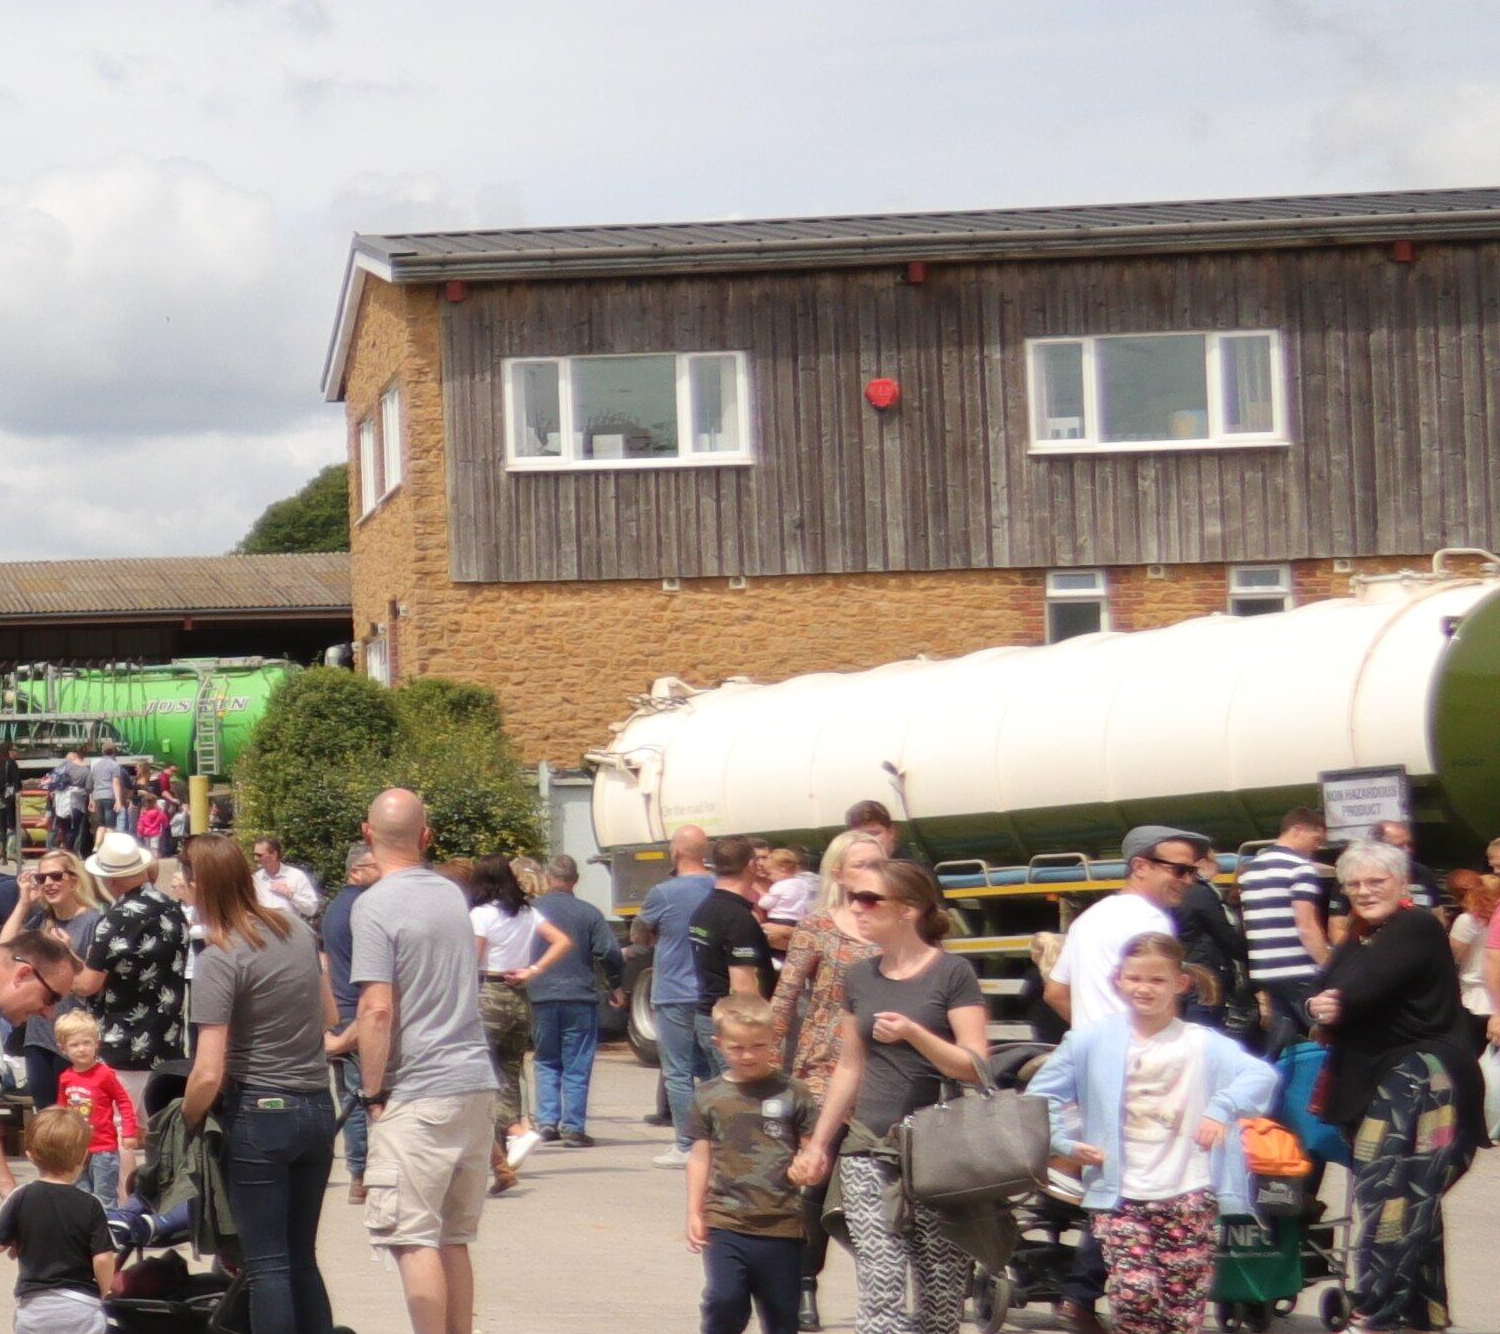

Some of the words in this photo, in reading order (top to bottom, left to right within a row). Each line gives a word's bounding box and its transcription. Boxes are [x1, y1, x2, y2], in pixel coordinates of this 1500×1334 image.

[146, 695, 250, 715] JOSIN
[1344, 785, 1397, 800] HAZARDOUS
[1342, 802, 1382, 817] PRODUCT
